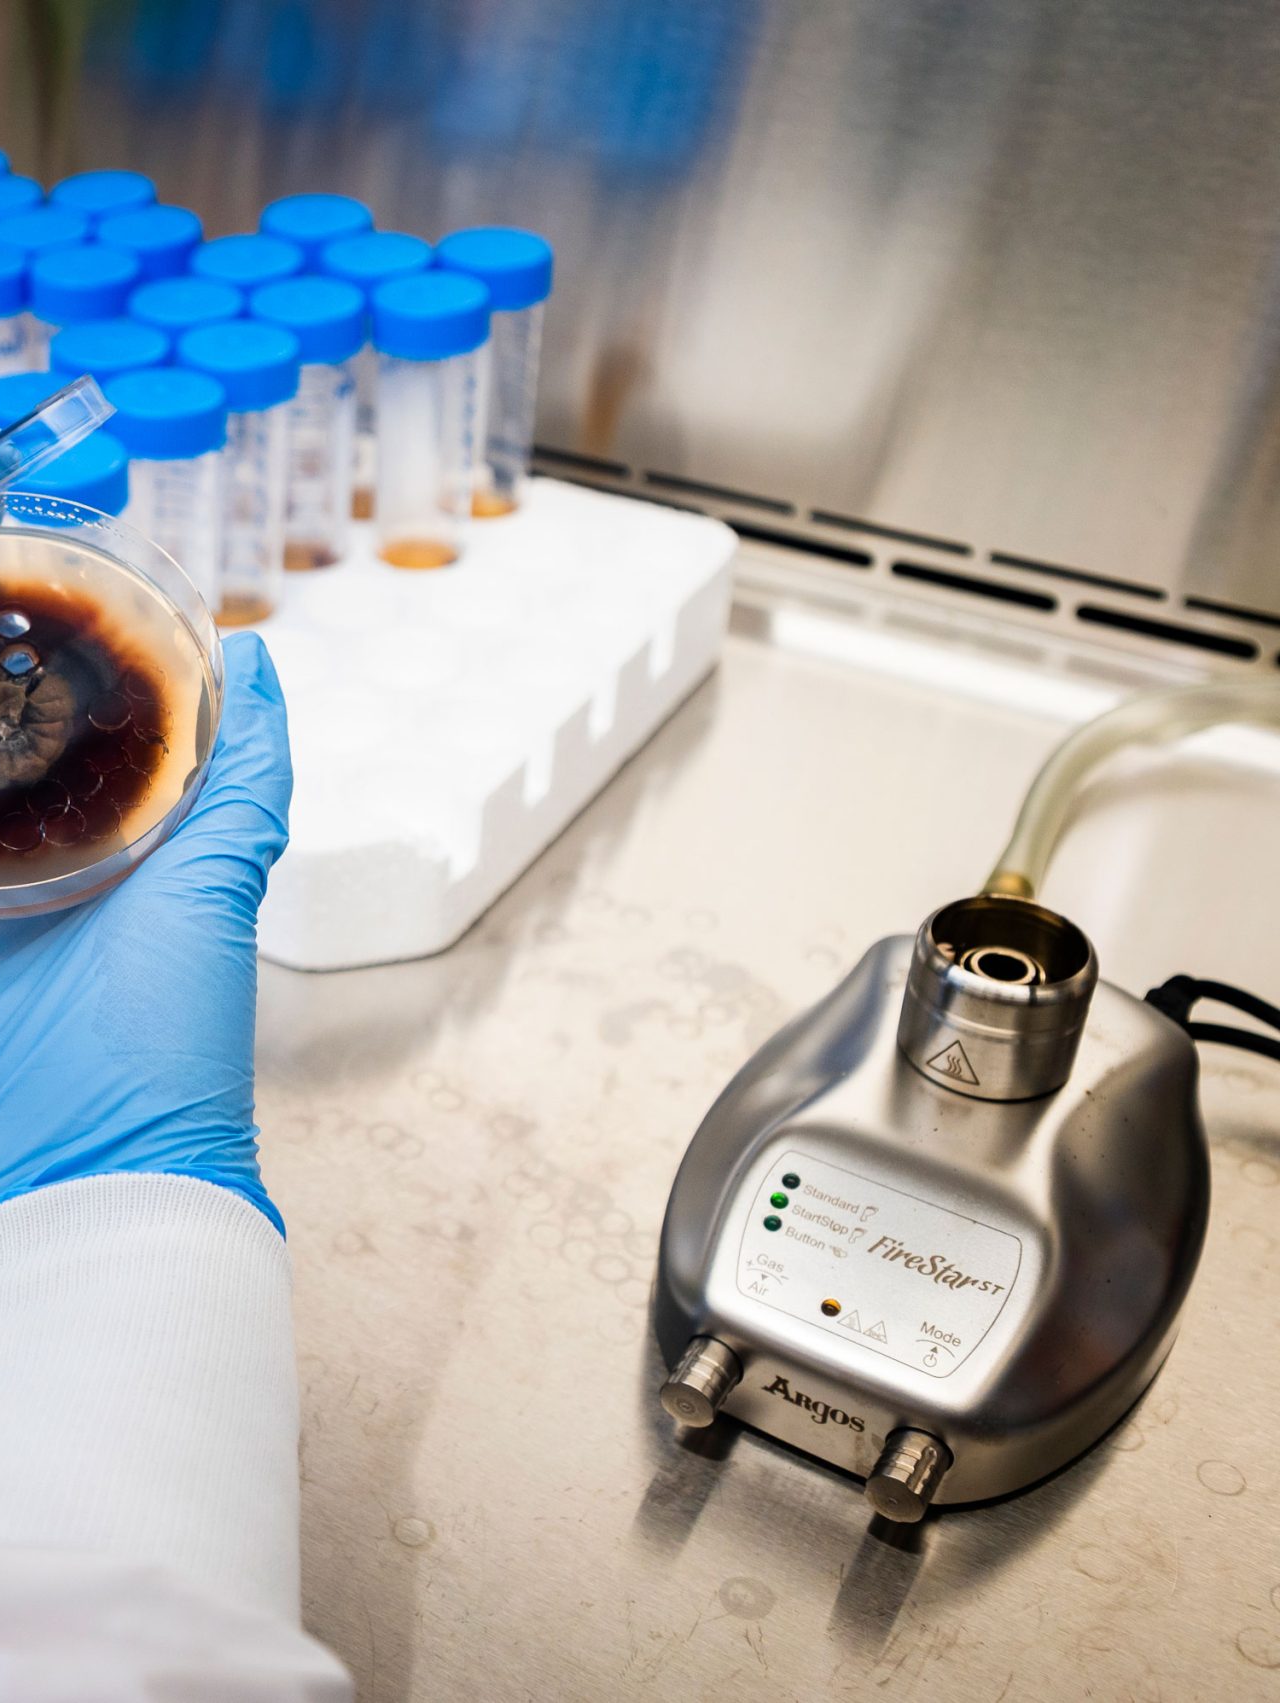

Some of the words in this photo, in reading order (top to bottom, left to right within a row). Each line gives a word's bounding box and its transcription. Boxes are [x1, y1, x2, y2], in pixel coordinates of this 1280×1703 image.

[803, 1184, 860, 1214] Standard
[791, 1204, 849, 1235] StartStop
[785, 1226, 826, 1250] Button
[756, 1253, 785, 1273] Gas
[747, 1281, 770, 1296] Air
[920, 1321, 962, 1347] Mode
